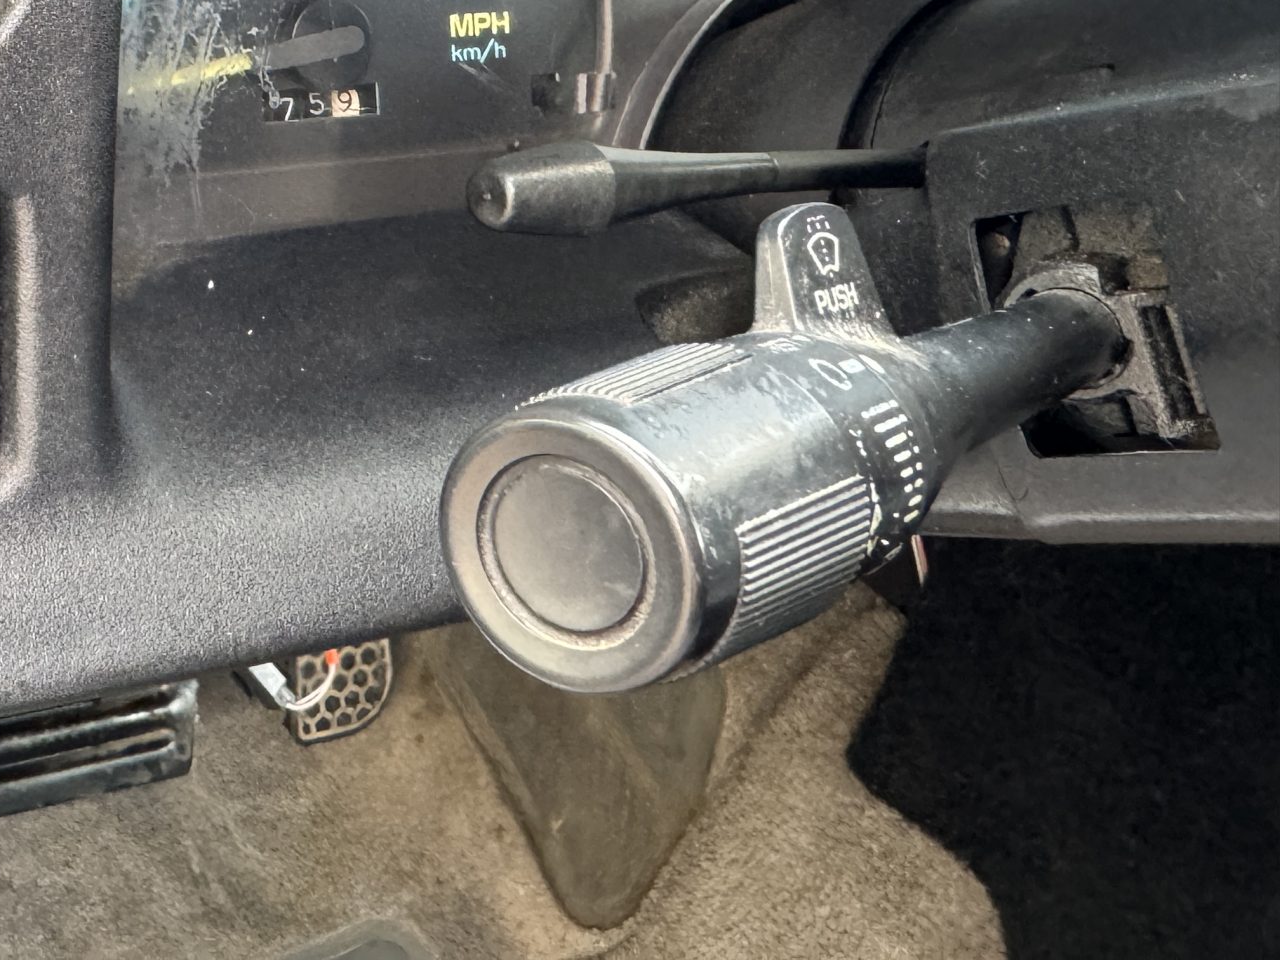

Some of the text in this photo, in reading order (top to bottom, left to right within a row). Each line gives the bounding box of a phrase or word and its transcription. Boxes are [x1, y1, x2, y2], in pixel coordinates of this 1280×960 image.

[449, 11, 510, 37] MPH
[451, 37, 507, 63] km/h
[814, 282, 860, 315] PUSH
